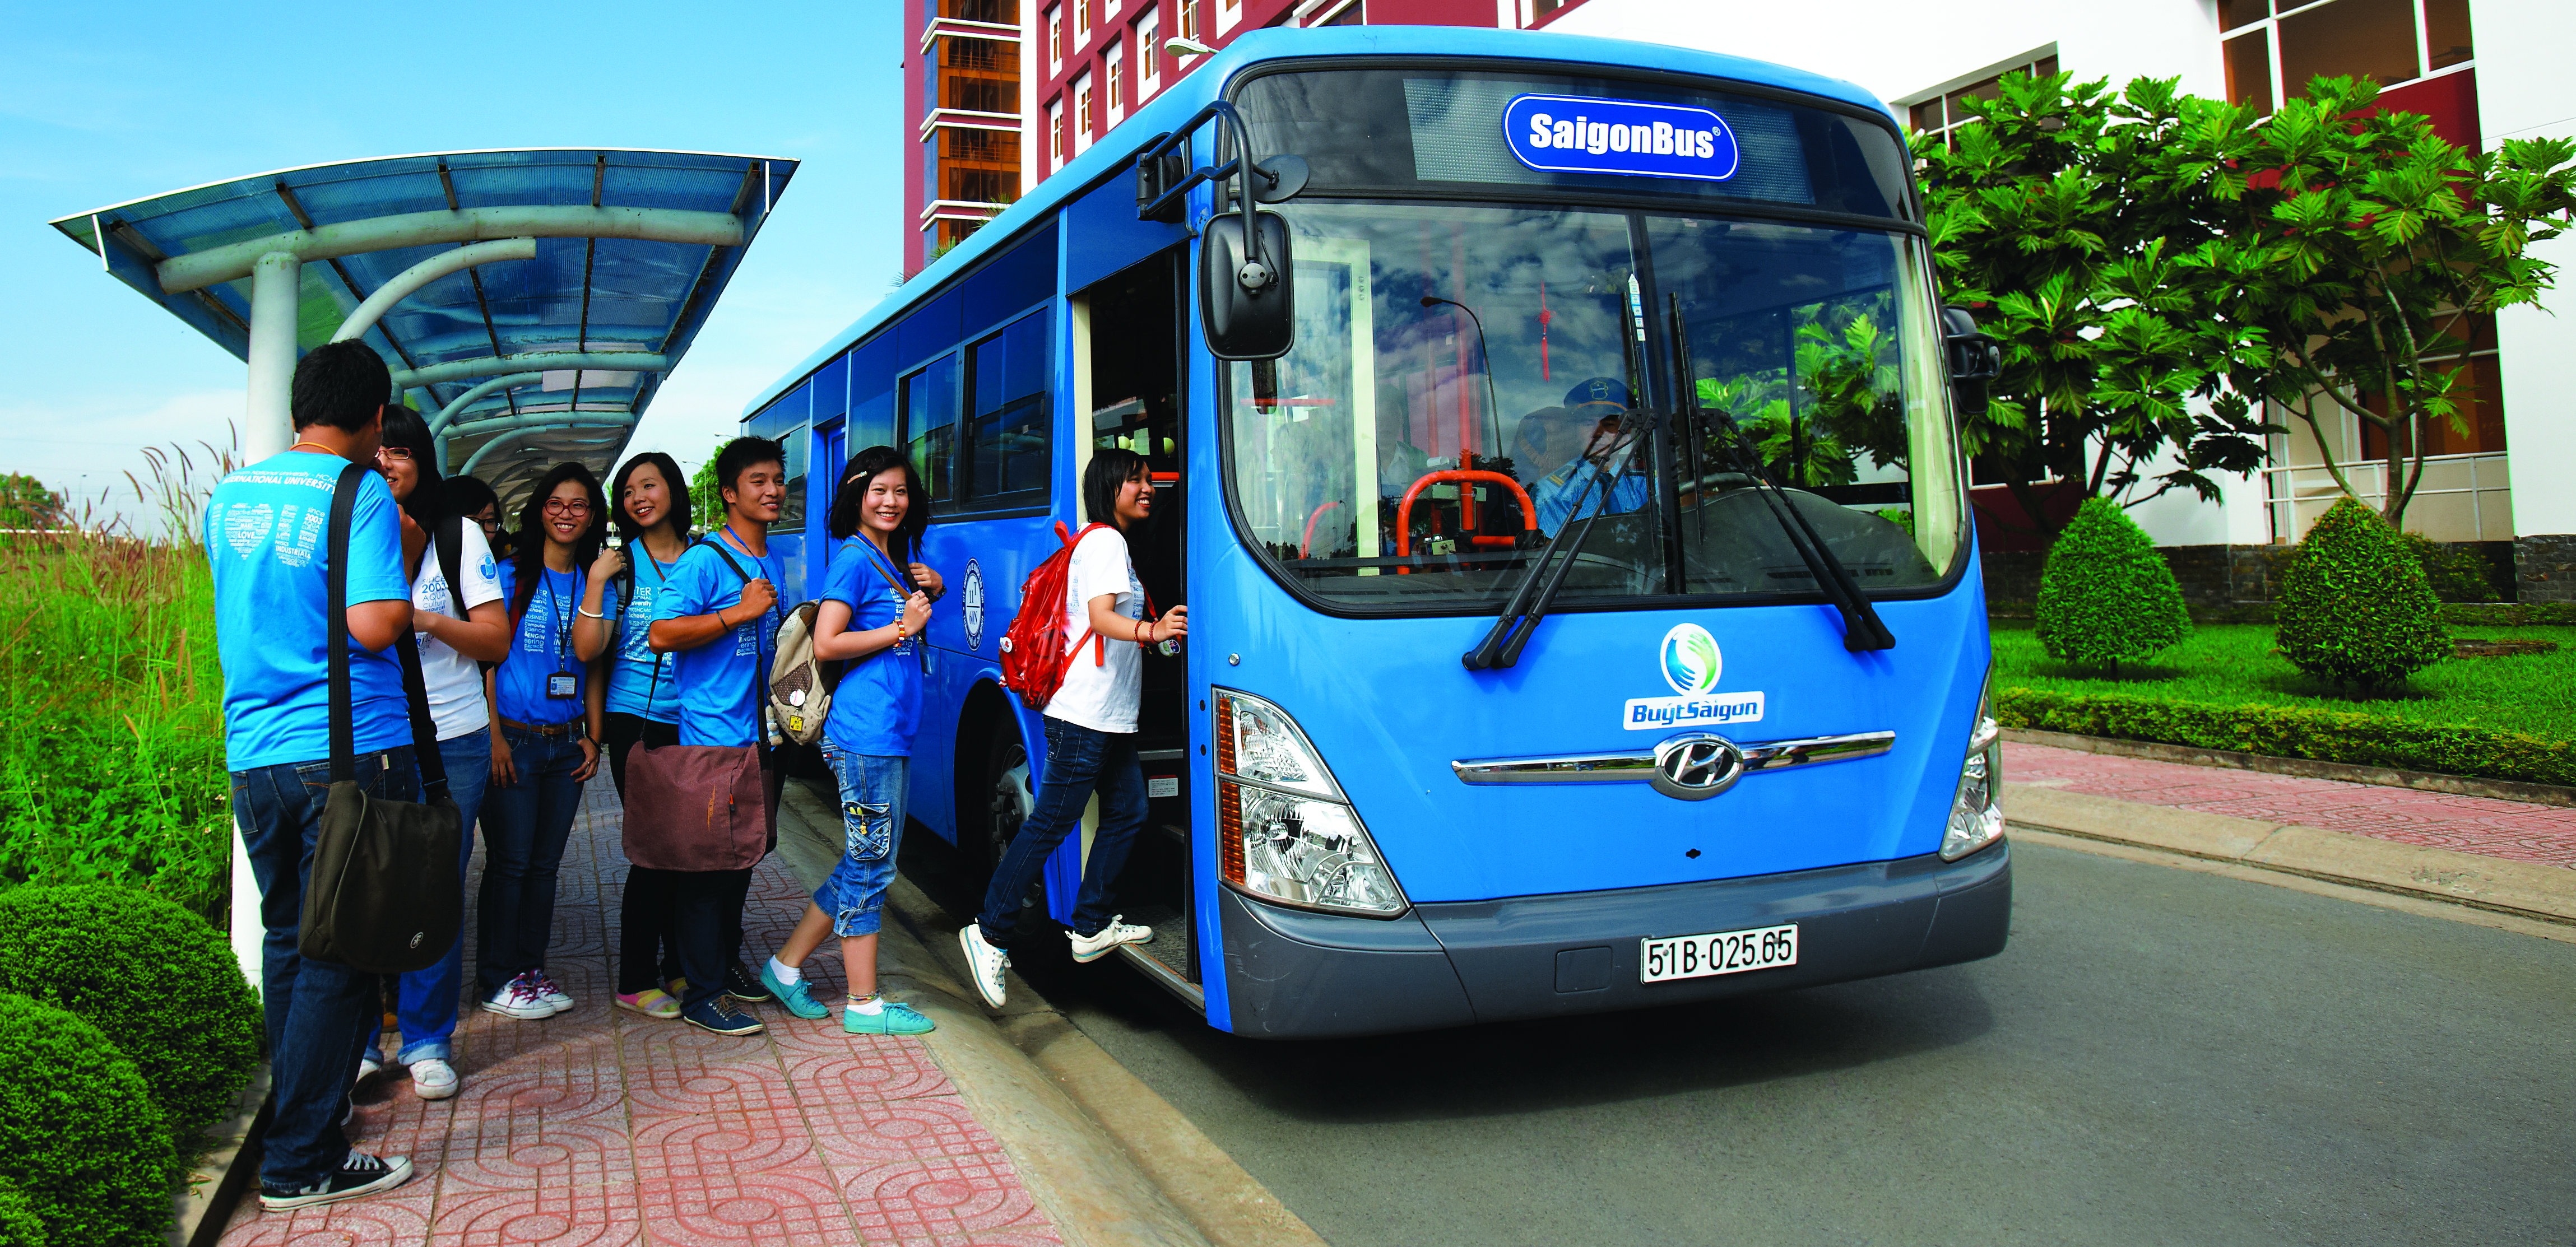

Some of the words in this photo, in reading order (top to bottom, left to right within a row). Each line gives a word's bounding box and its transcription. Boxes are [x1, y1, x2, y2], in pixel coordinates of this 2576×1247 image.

[308, 506, 325, 517] since
[305, 513, 323, 524] 2003
[423, 592, 446, 602] AQUA
[423, 599, 446, 608] culture
[1649, 929, 1792, 976] 51B-025.65
